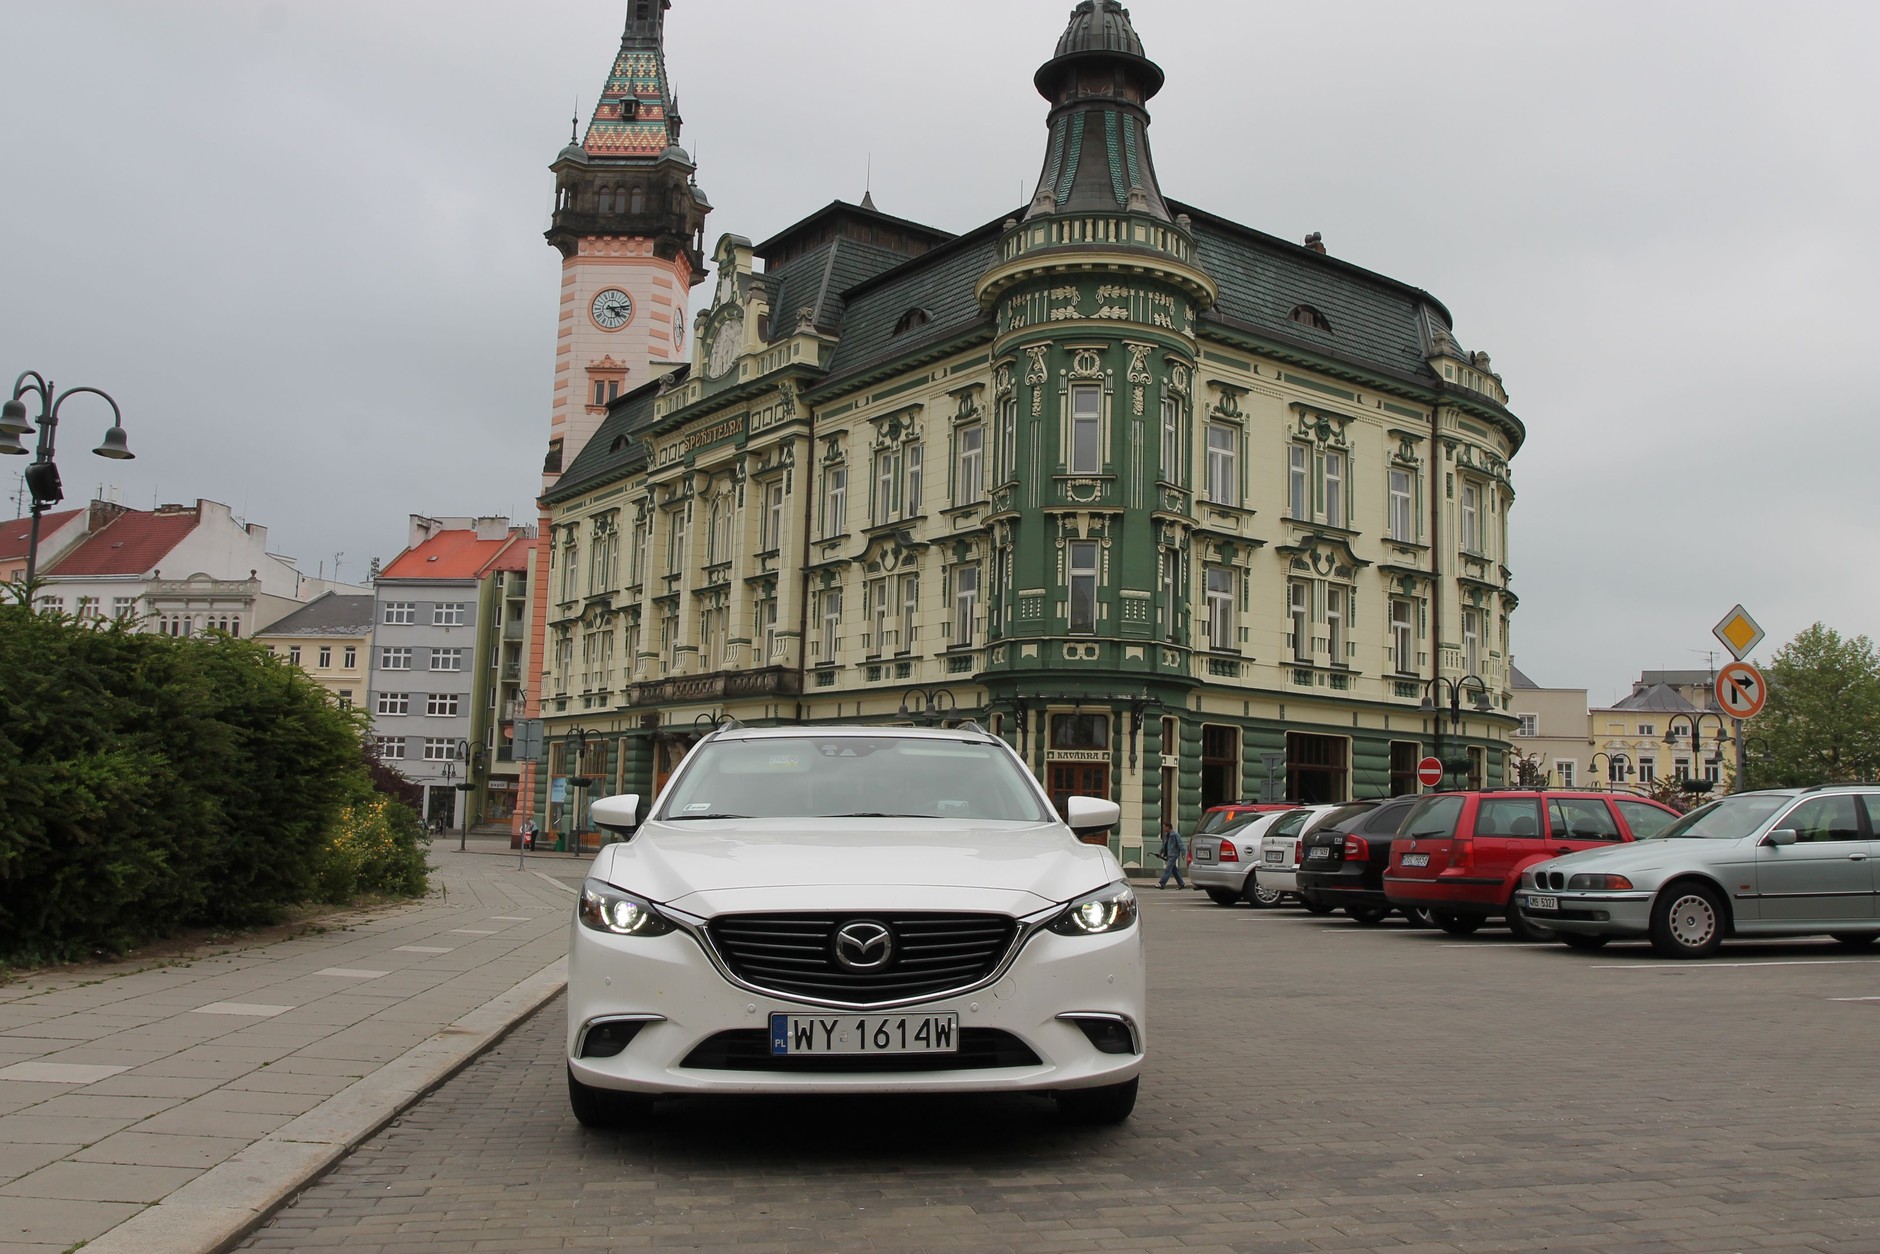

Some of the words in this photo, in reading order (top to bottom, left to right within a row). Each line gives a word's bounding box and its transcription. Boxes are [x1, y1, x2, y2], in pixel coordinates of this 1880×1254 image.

[774, 1039, 786, 1048] PL
[793, 1019, 839, 1050] WY
[855, 1017, 952, 1050] 1614W
